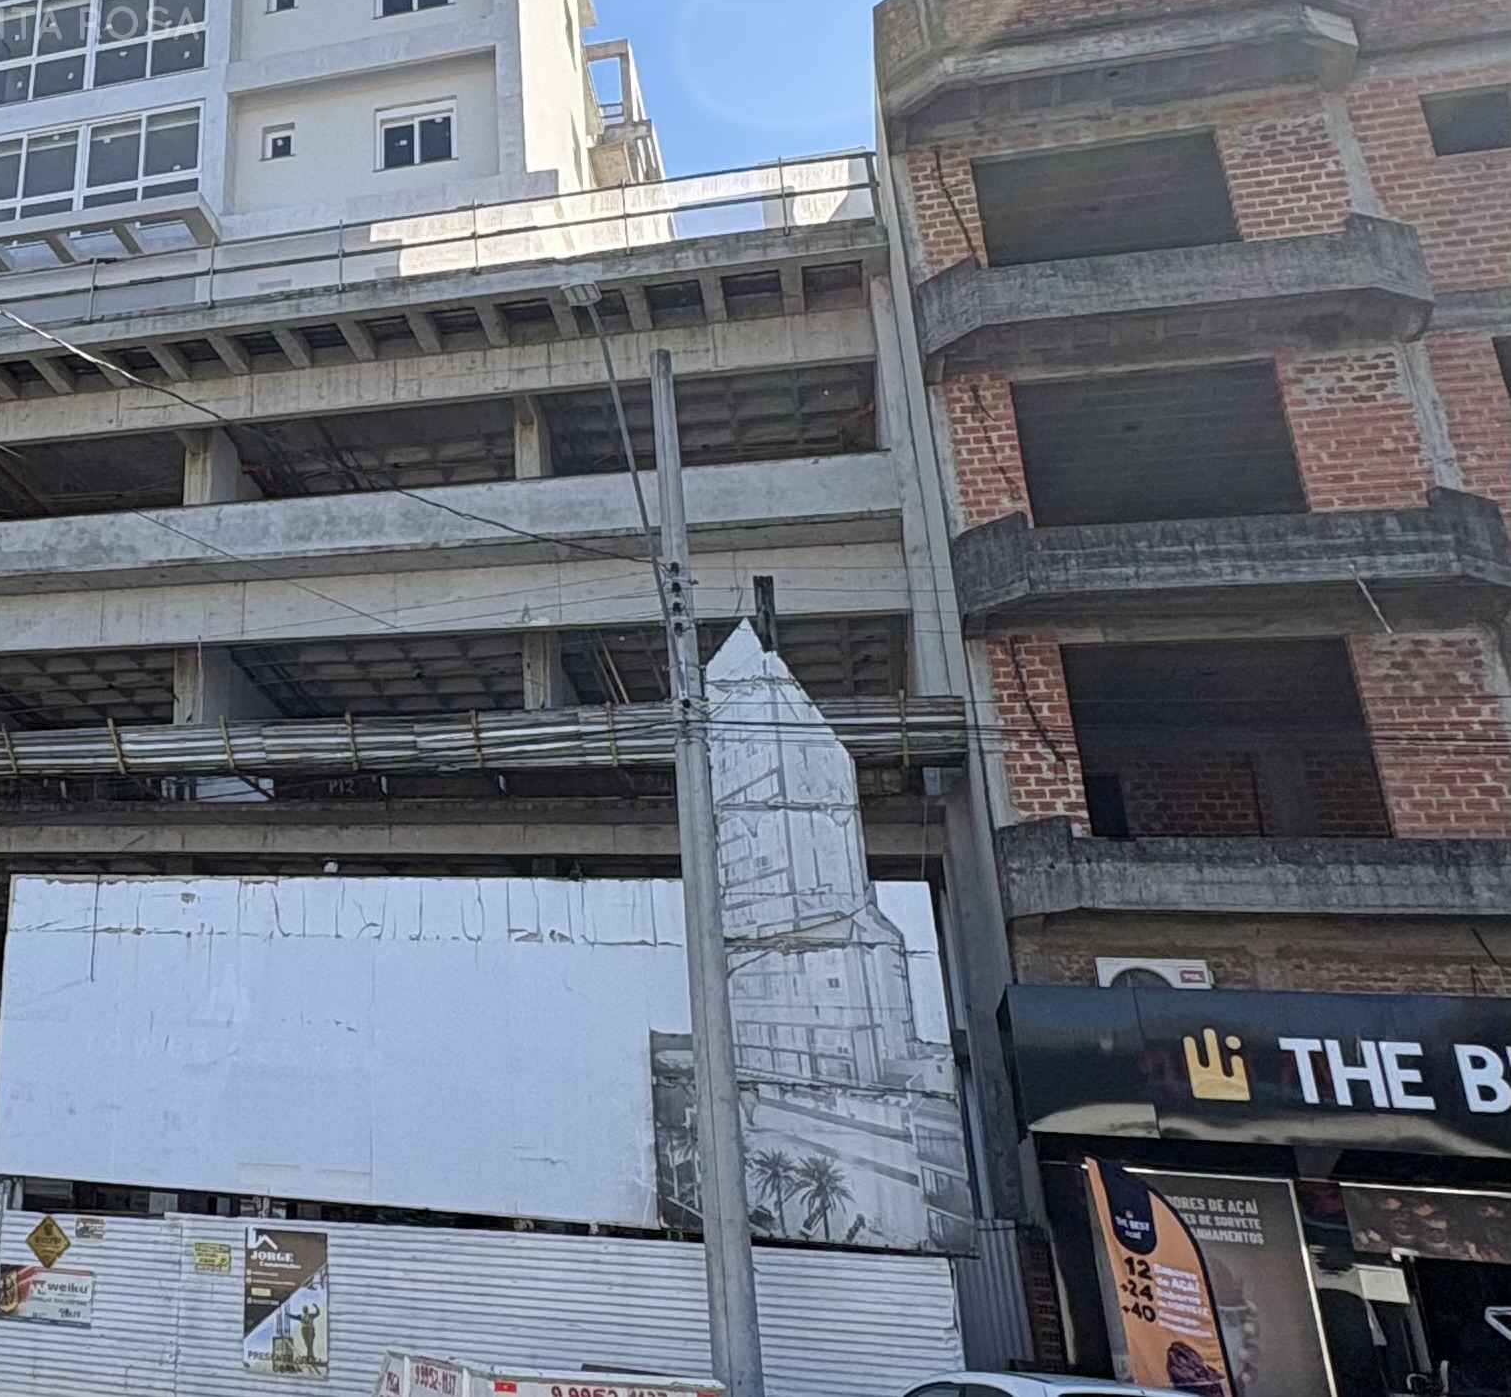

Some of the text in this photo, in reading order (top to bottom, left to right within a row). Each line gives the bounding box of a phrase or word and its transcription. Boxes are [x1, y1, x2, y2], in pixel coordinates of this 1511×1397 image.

[1278, 1037, 1511, 1113] THE B
[1208, 1198, 1226, 1213] DE
[1228, 1199, 1258, 1216] AÇAÍ
[1214, 1215, 1262, 1230] SORVETE
[250, 1250, 294, 1263] JORGE
[1124, 1256, 1153, 1281] 12
[47, 1282, 89, 1294] weiku
